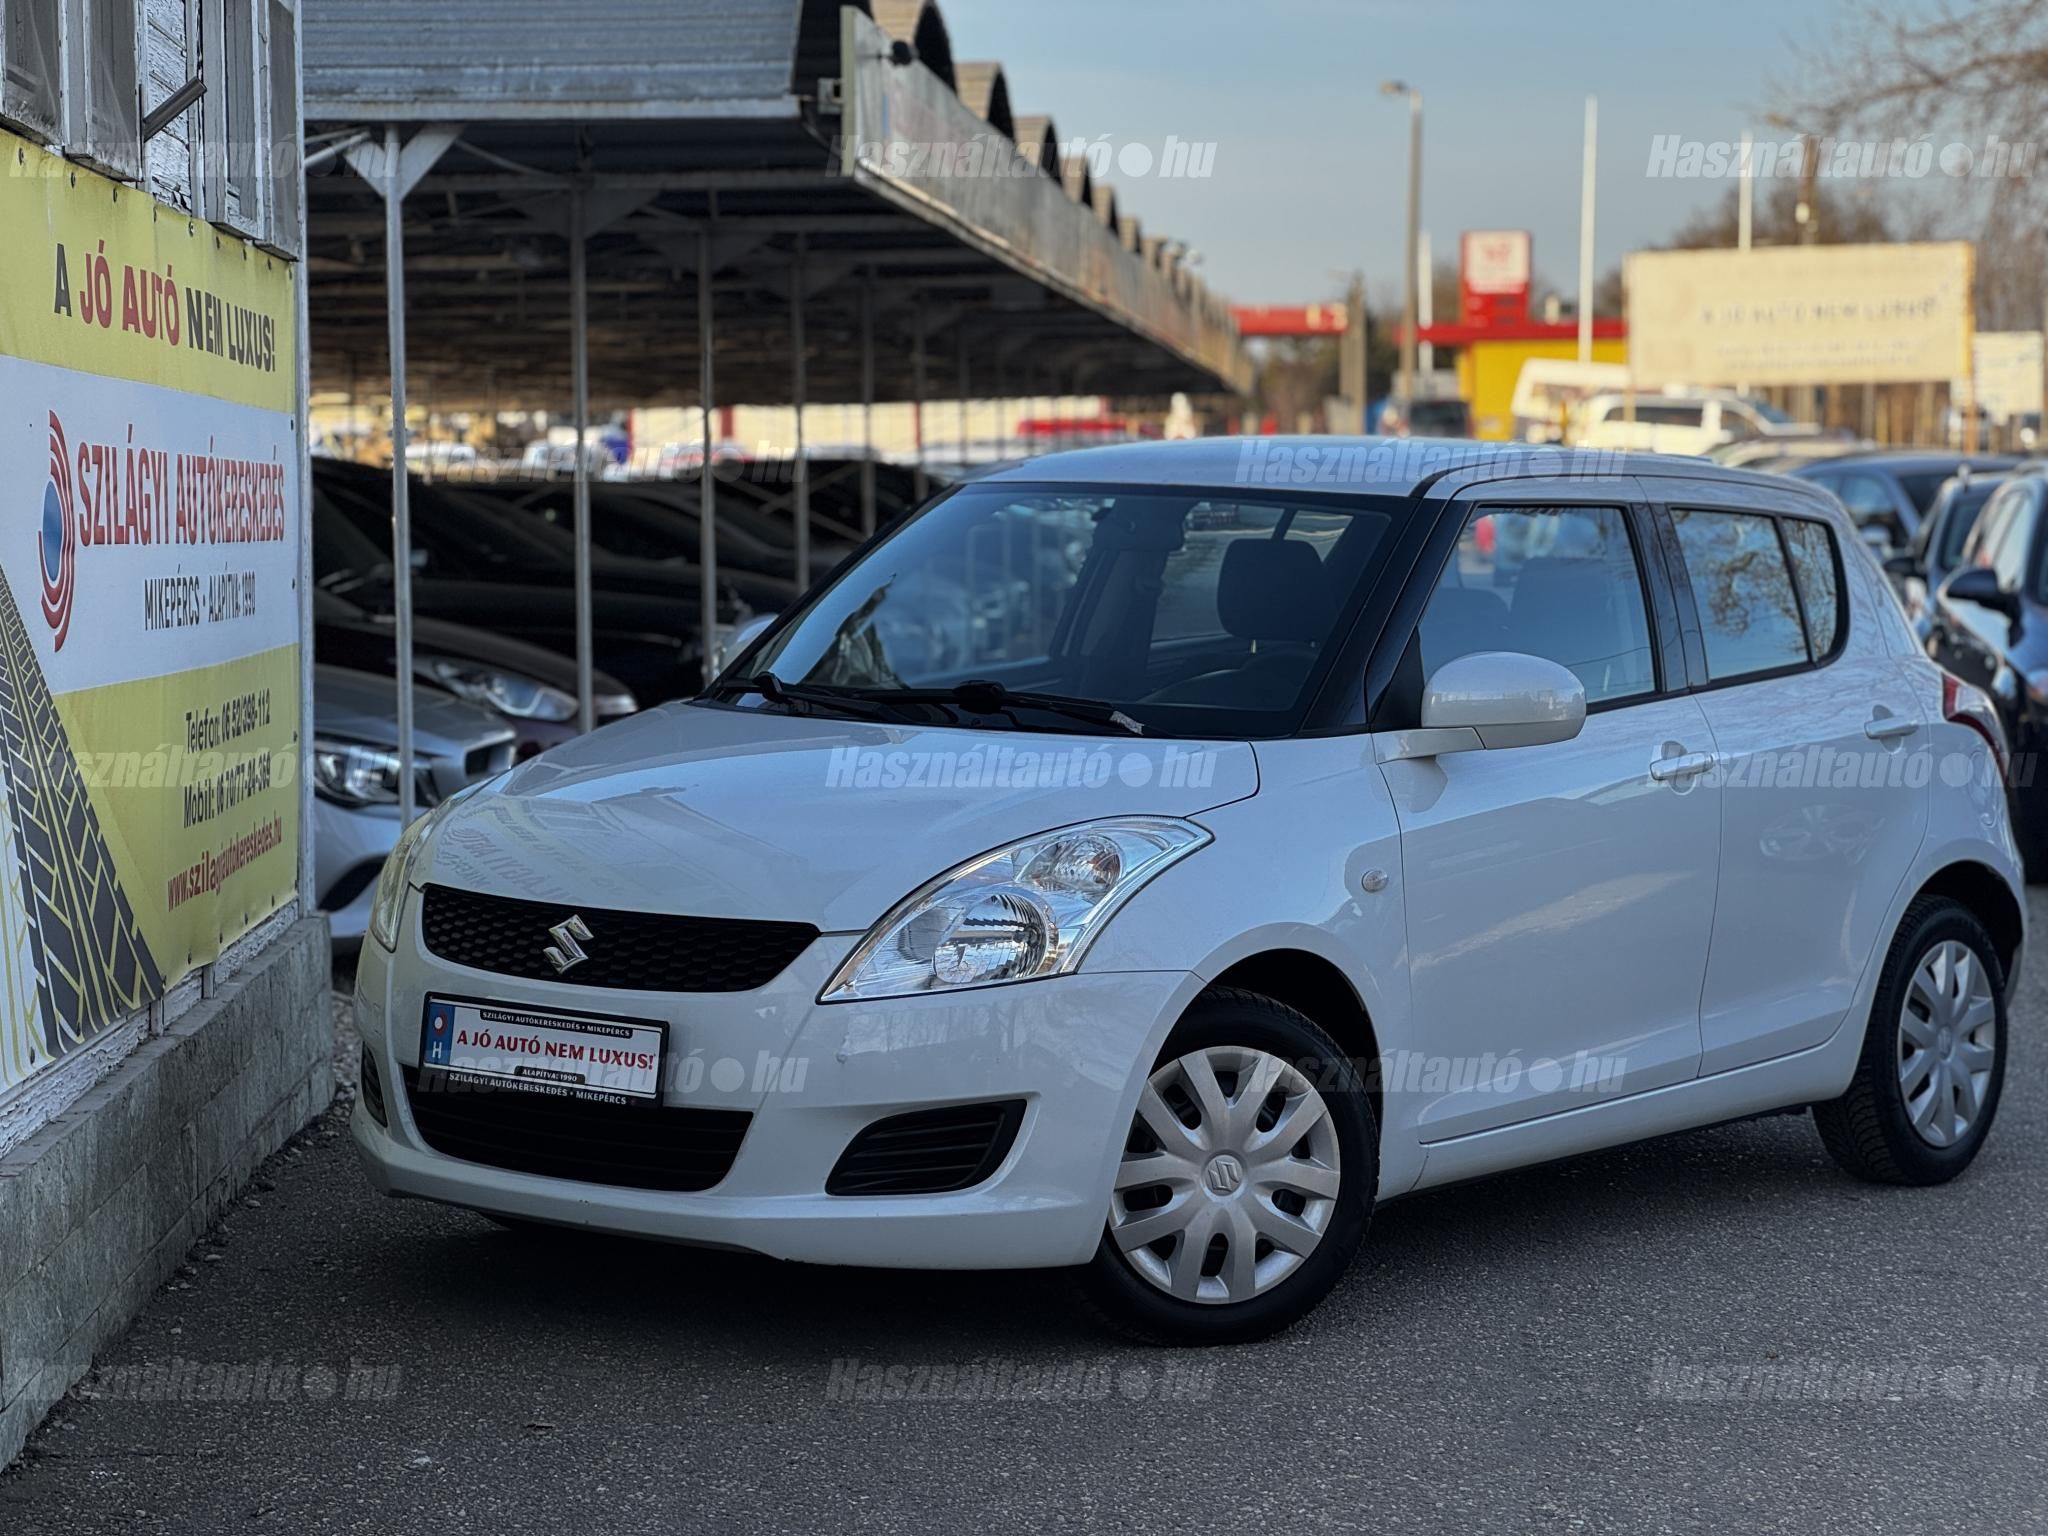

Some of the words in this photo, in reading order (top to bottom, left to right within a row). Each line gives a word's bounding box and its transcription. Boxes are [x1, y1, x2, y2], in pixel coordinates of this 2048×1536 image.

[54, 243, 72, 317] A
[80, 239, 112, 328] JÓ
[122, 264, 180, 346] AUTÓ
[186, 287, 224, 356] NEM
[226, 302, 276, 372] LUXUS!
[77, 424, 169, 547] SZILÁGYI
[175, 435, 284, 545] AUTÓKERESKEDÉS
[144, 563, 200, 631] MIKEPÉRCS
[208, 561, 240, 623] ALAPÍTVA:
[242, 570, 256, 617] 1990
[186, 708, 220, 754] Telefon:
[222, 702, 230, 743] 06
[184, 778, 215, 829] Mobil:
[216, 773, 224, 816] 06
[482, 1011, 514, 1022] SZILÁGYI
[514, 1014, 580, 1030] AUTÓKERESKEDÉS
[586, 1024, 630, 1037] MIKEPÉRCS
[432, 1041, 442, 1059] H
[457, 1030, 468, 1045] A
[472, 1028, 492, 1048] JÓ
[494, 1034, 540, 1054] AUTÓ
[544, 1041, 584, 1061] NEM
[589, 1046, 656, 1070] LUXUS!
[448, 1072, 488, 1086] SZILÁGYI
[490, 1076, 568, 1097] AUTÓKERESKEDÉS
[576, 1090, 626, 1105] MIKEPÉRCS
[522, 1068, 558, 1080] ALAPÍTVA:
[560, 1074, 578, 1082] 1990
